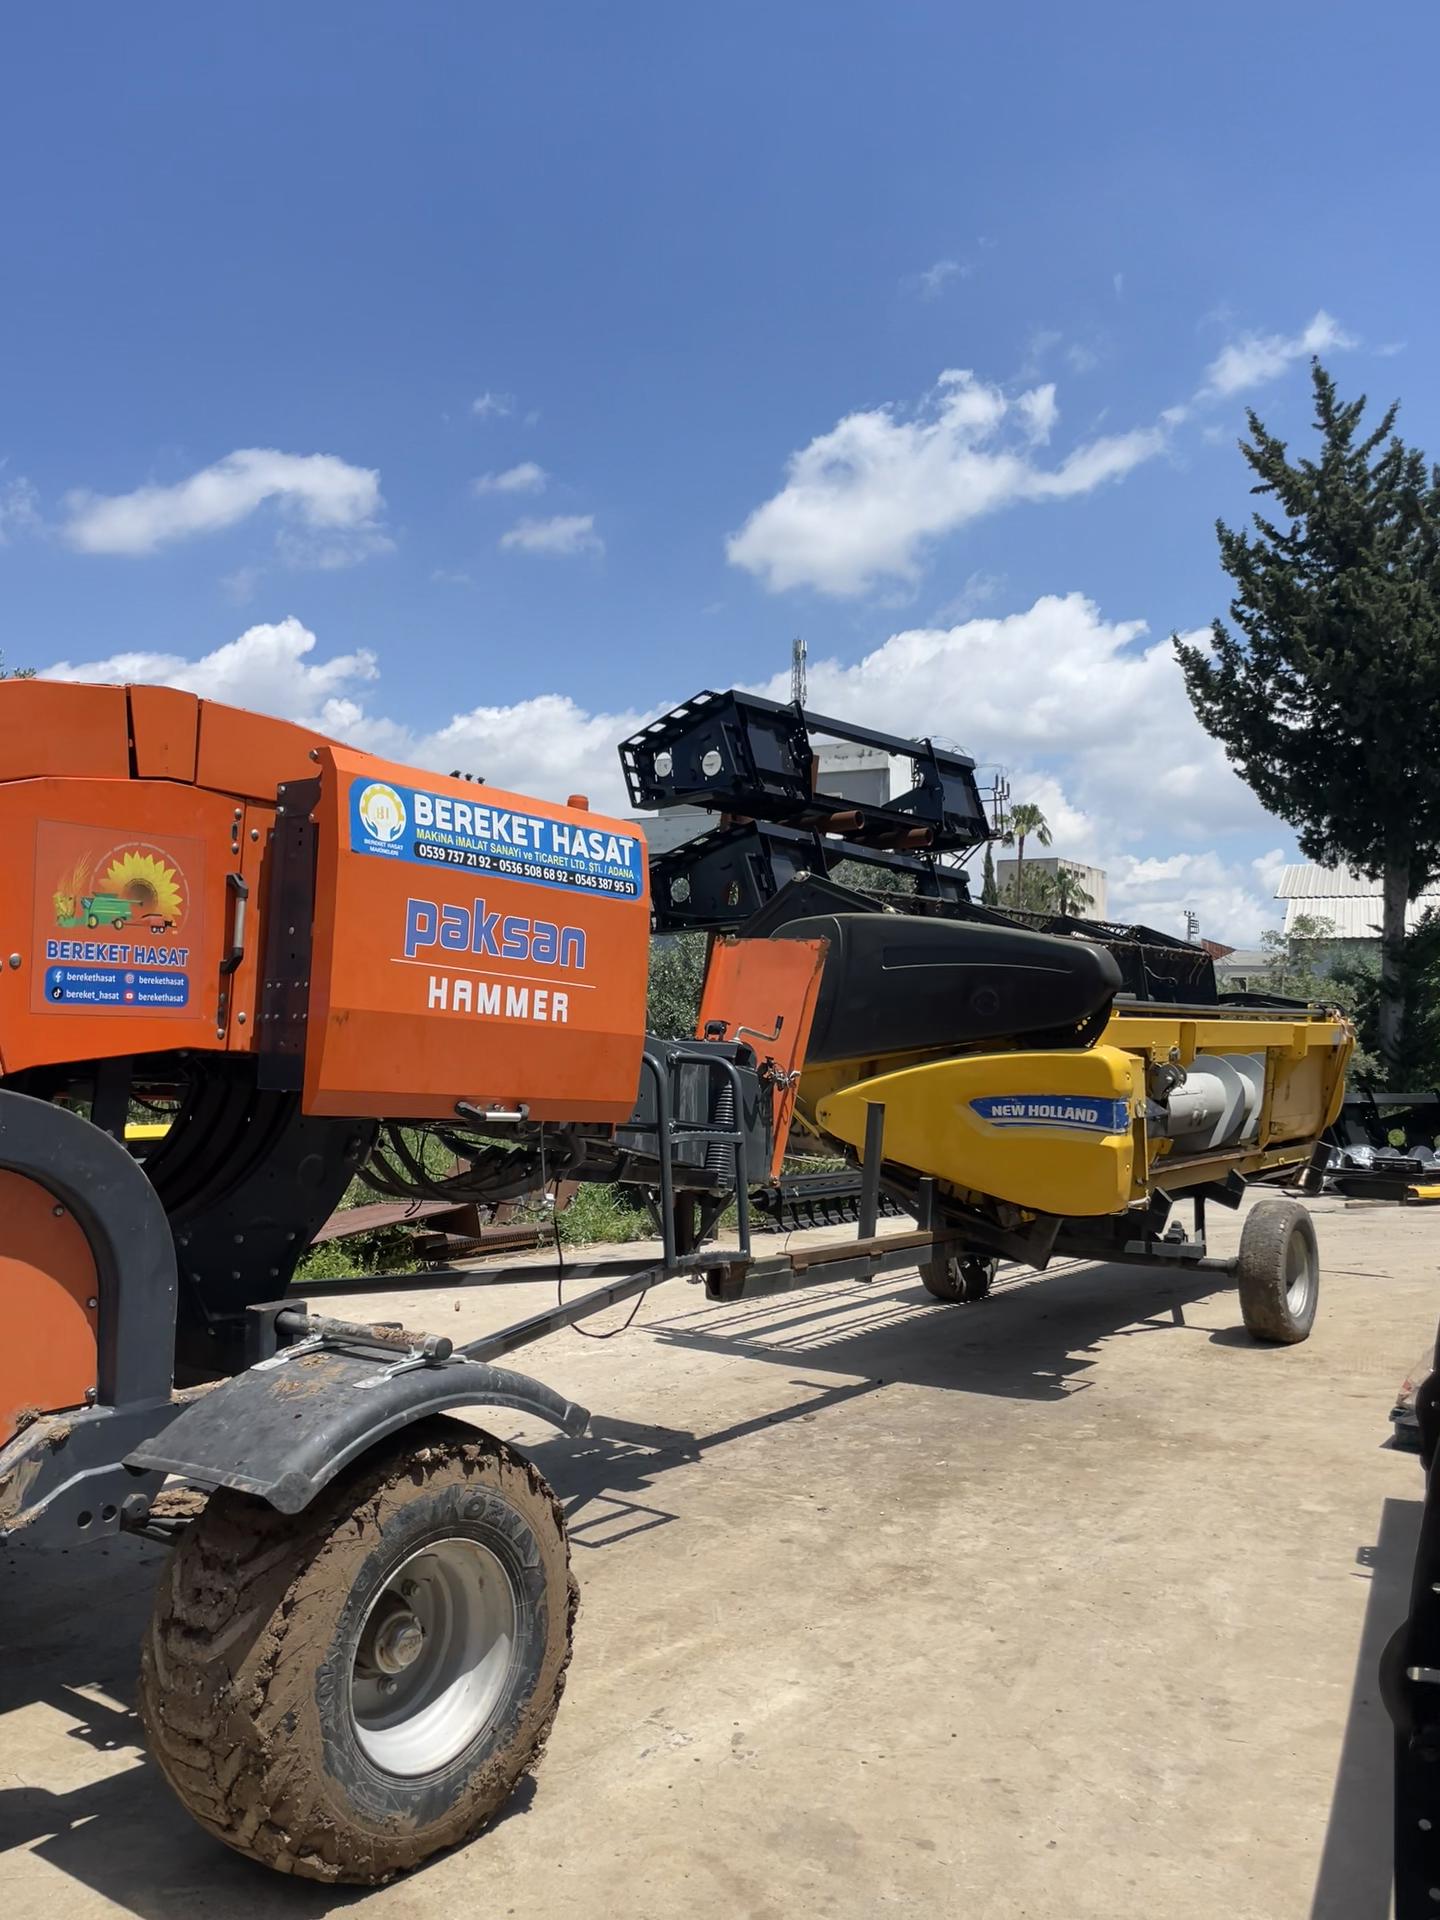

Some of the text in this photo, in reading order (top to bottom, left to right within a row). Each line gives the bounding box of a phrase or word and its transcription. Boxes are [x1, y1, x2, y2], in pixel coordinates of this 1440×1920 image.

[414, 793, 633, 866] BEREKET HASAT
[419, 844, 445, 860] 0539
[447, 849, 465, 863] 737
[467, 853, 477, 866] 21
[479, 855, 491, 869] 92
[499, 859, 523, 874] 0536
[524, 864, 542, 878] 508
[543, 867, 555, 881] 68
[556, 869, 568, 883] 92
[575, 873, 597, 887] 0545
[597, 878, 613, 890] 387
[614, 880, 625, 892] 95
[625, 882, 634, 894] 51
[608, 865, 634, 879] ADANA
[404, 898, 587, 970] paksan
[46, 938, 189, 967] BEREKET HASAT
[66, 971, 116, 983] berekethasat
[138, 975, 184, 986] berekethasat
[66, 989, 120, 1001] bereket_hasat
[138, 992, 184, 1003] berekethasat
[428, 976, 569, 1023] HAMMER
[991, 1104, 1098, 1123] NEW HOLLAND
